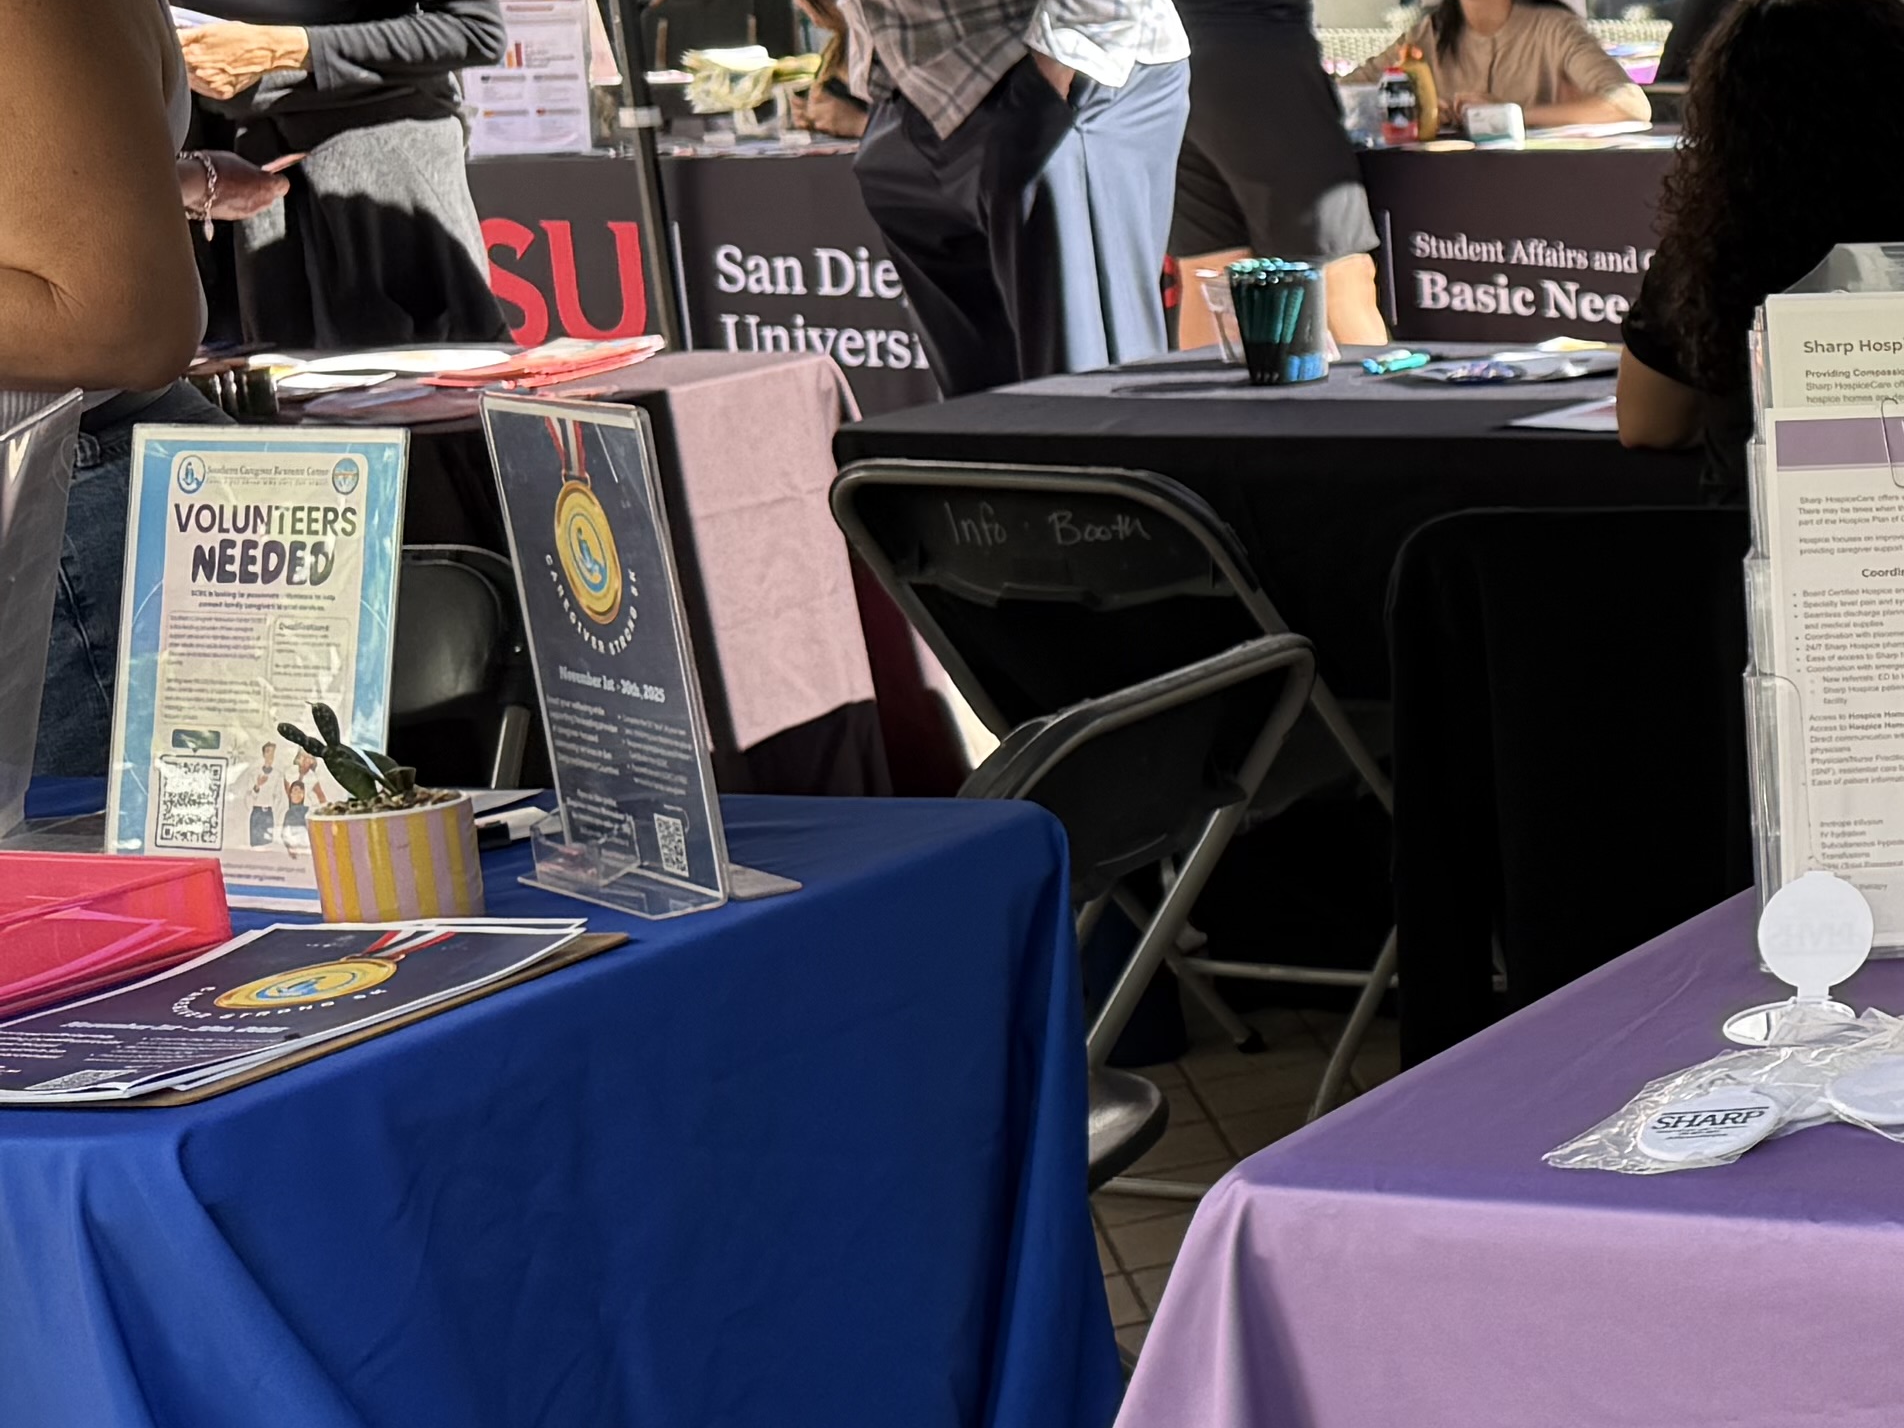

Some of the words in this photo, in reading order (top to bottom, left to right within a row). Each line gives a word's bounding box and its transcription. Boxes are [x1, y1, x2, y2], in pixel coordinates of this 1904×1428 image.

[1412, 231, 1506, 263] Student
[1511, 238, 1589, 270] Affairs
[1593, 245, 1638, 273] and
[714, 244, 808, 295] San
[813, 246, 912, 308] Die
[1415, 269, 1536, 316] Basic
[1539, 278, 1630, 324] Nee
[719, 314, 930, 370] Universi
[1804, 338, 1853, 354] Sharp
[174, 503, 357, 537] VOLUNTEERS
[944, 502, 1007, 547] Info
[1048, 510, 1151, 546] Booth
[191, 539, 335, 586] NEEDED
[1651, 1110, 1766, 1130] SHARP
